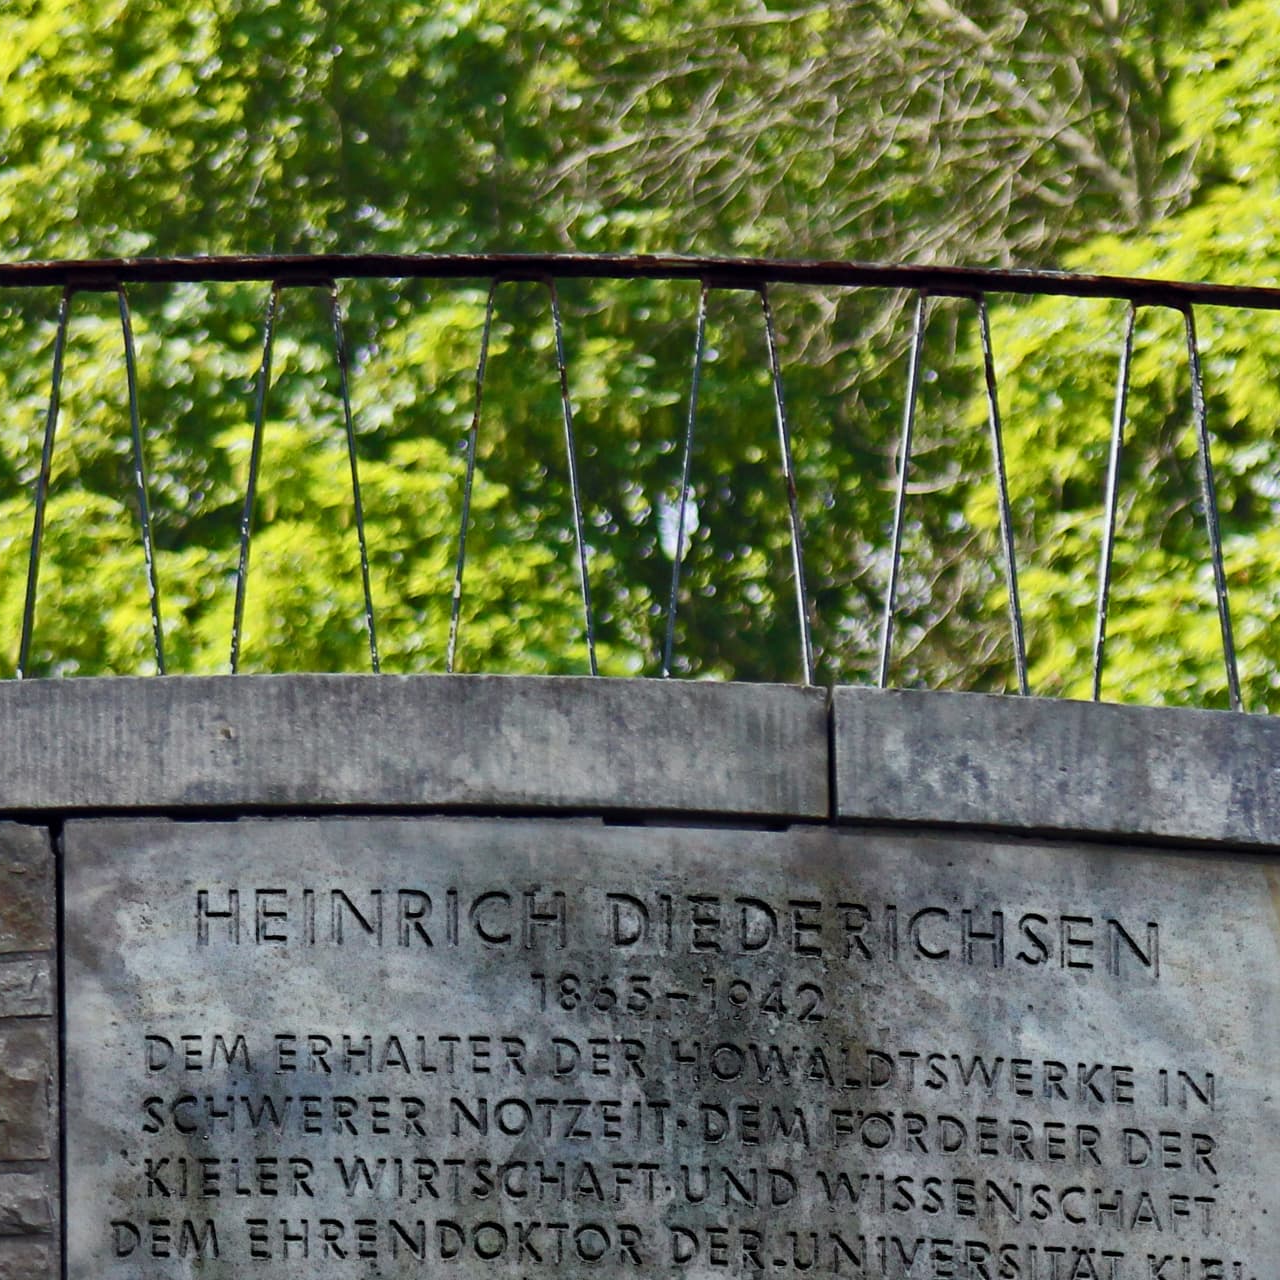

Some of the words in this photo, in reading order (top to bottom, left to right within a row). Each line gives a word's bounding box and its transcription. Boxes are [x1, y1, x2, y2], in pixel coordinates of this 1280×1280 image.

[195, 888, 567, 950] HEINRICH
[606, 892, 1160, 979] DIEDERICHSEN
[144, 1034, 251, 1075] DEM
[274, 1034, 527, 1077] ERHALTER
[550, 1036, 646, 1079] DER
[670, 1038, 1135, 1105] HOWALDTSWERKE
[1157, 1069, 1215, 1111] IN
[141, 1095, 426, 1137] SCHWERER
[701, 1103, 810, 1147] DEM
[830, 1108, 1103, 1167] FÖRDERER
[1122, 1127, 1220, 1176] DER
[144, 1157, 316, 1199] KIELER
[681, 1165, 799, 1209] UND
[816, 1170, 1219, 1236] WISSENSCHAFT
[110, 1219, 220, 1259] DEM
[247, 1219, 644, 1266] EHRENDOKTOR
[670, 1224, 765, 1271] DER
